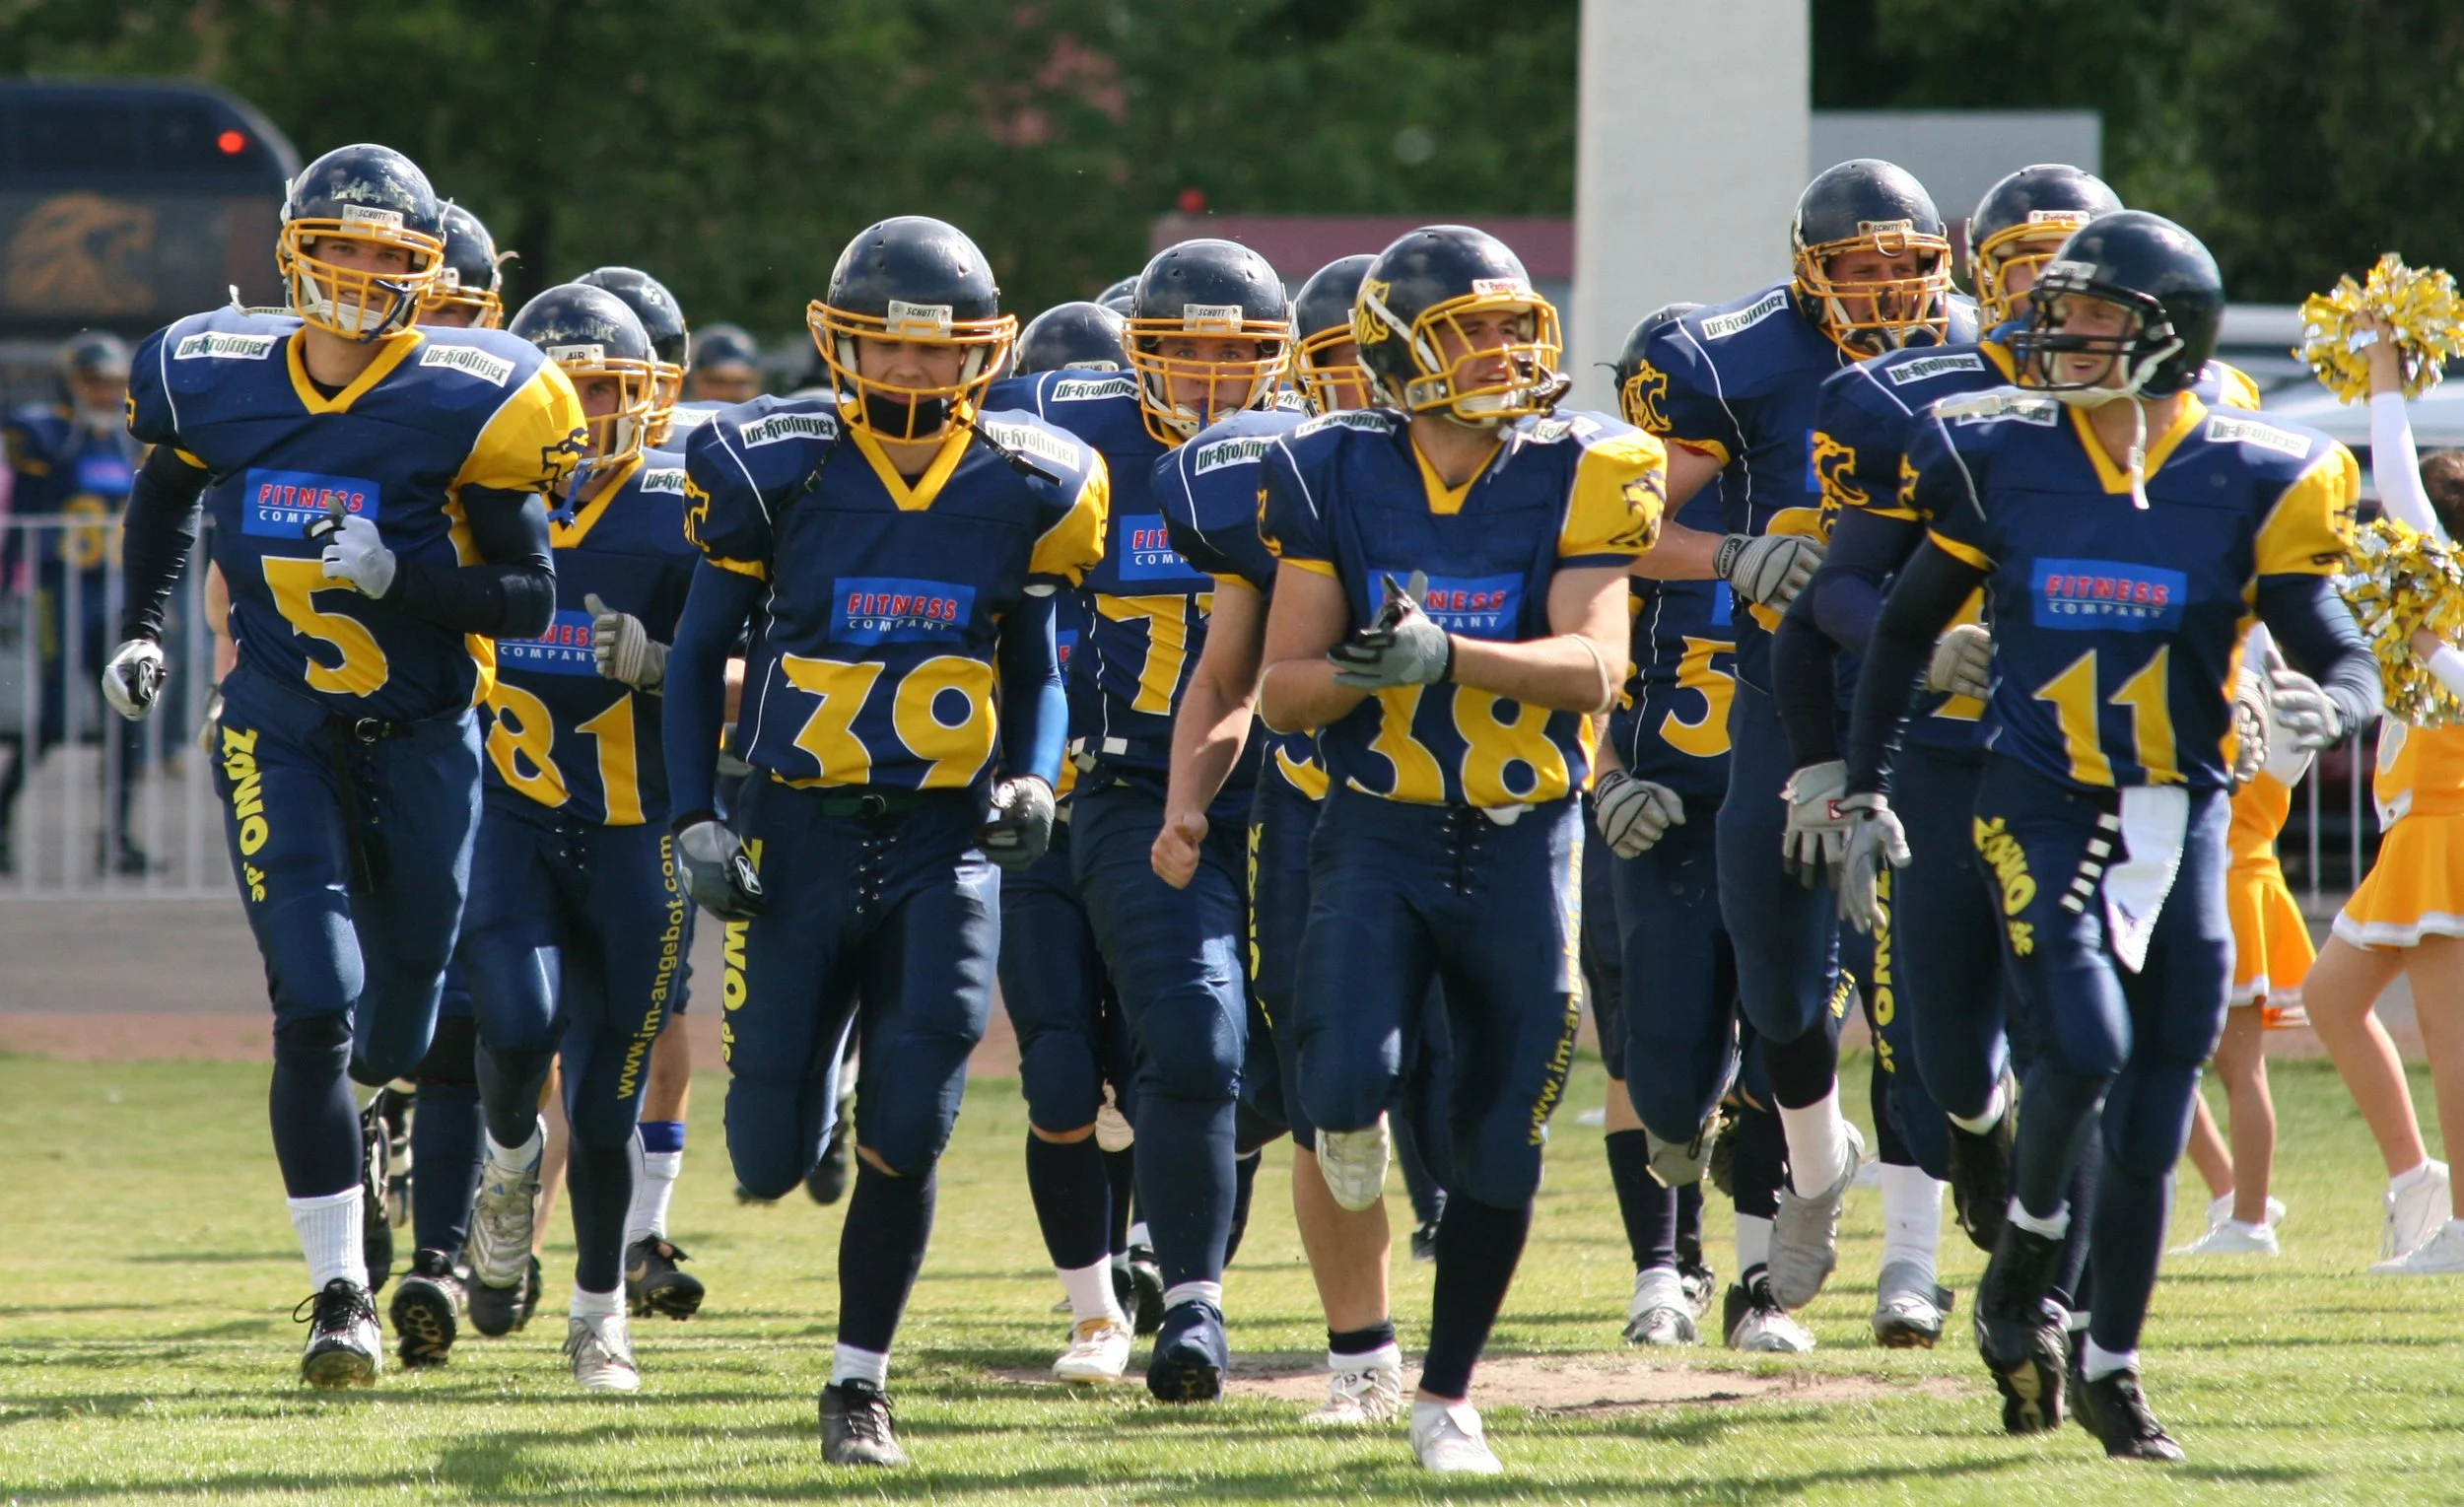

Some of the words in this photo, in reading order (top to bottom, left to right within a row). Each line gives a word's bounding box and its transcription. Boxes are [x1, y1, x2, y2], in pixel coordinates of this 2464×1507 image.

[358, 209, 387, 222] SCHUTT
[906, 307, 936, 318] SCHUTT
[1198, 308, 1226, 317] SCHUTT
[257, 483, 366, 513] FITNESS
[258, 509, 323, 524] COMP
[1427, 590, 1507, 611] NESS
[2045, 574, 2170, 607] FITNESS
[847, 593, 958, 622] FITNESS
[1438, 616, 1498, 628] PANY
[2049, 601, 2163, 619] COMPANY
[261, 555, 388, 698] 5
[849, 618, 953, 633] COMPANY
[782, 651, 994, 790] 39
[2032, 644, 2189, 788] 11
[487, 680, 647, 826] 81
[1346, 684, 1570, 807] 38
[617, 834, 685, 1101] www.im-angebot.com
